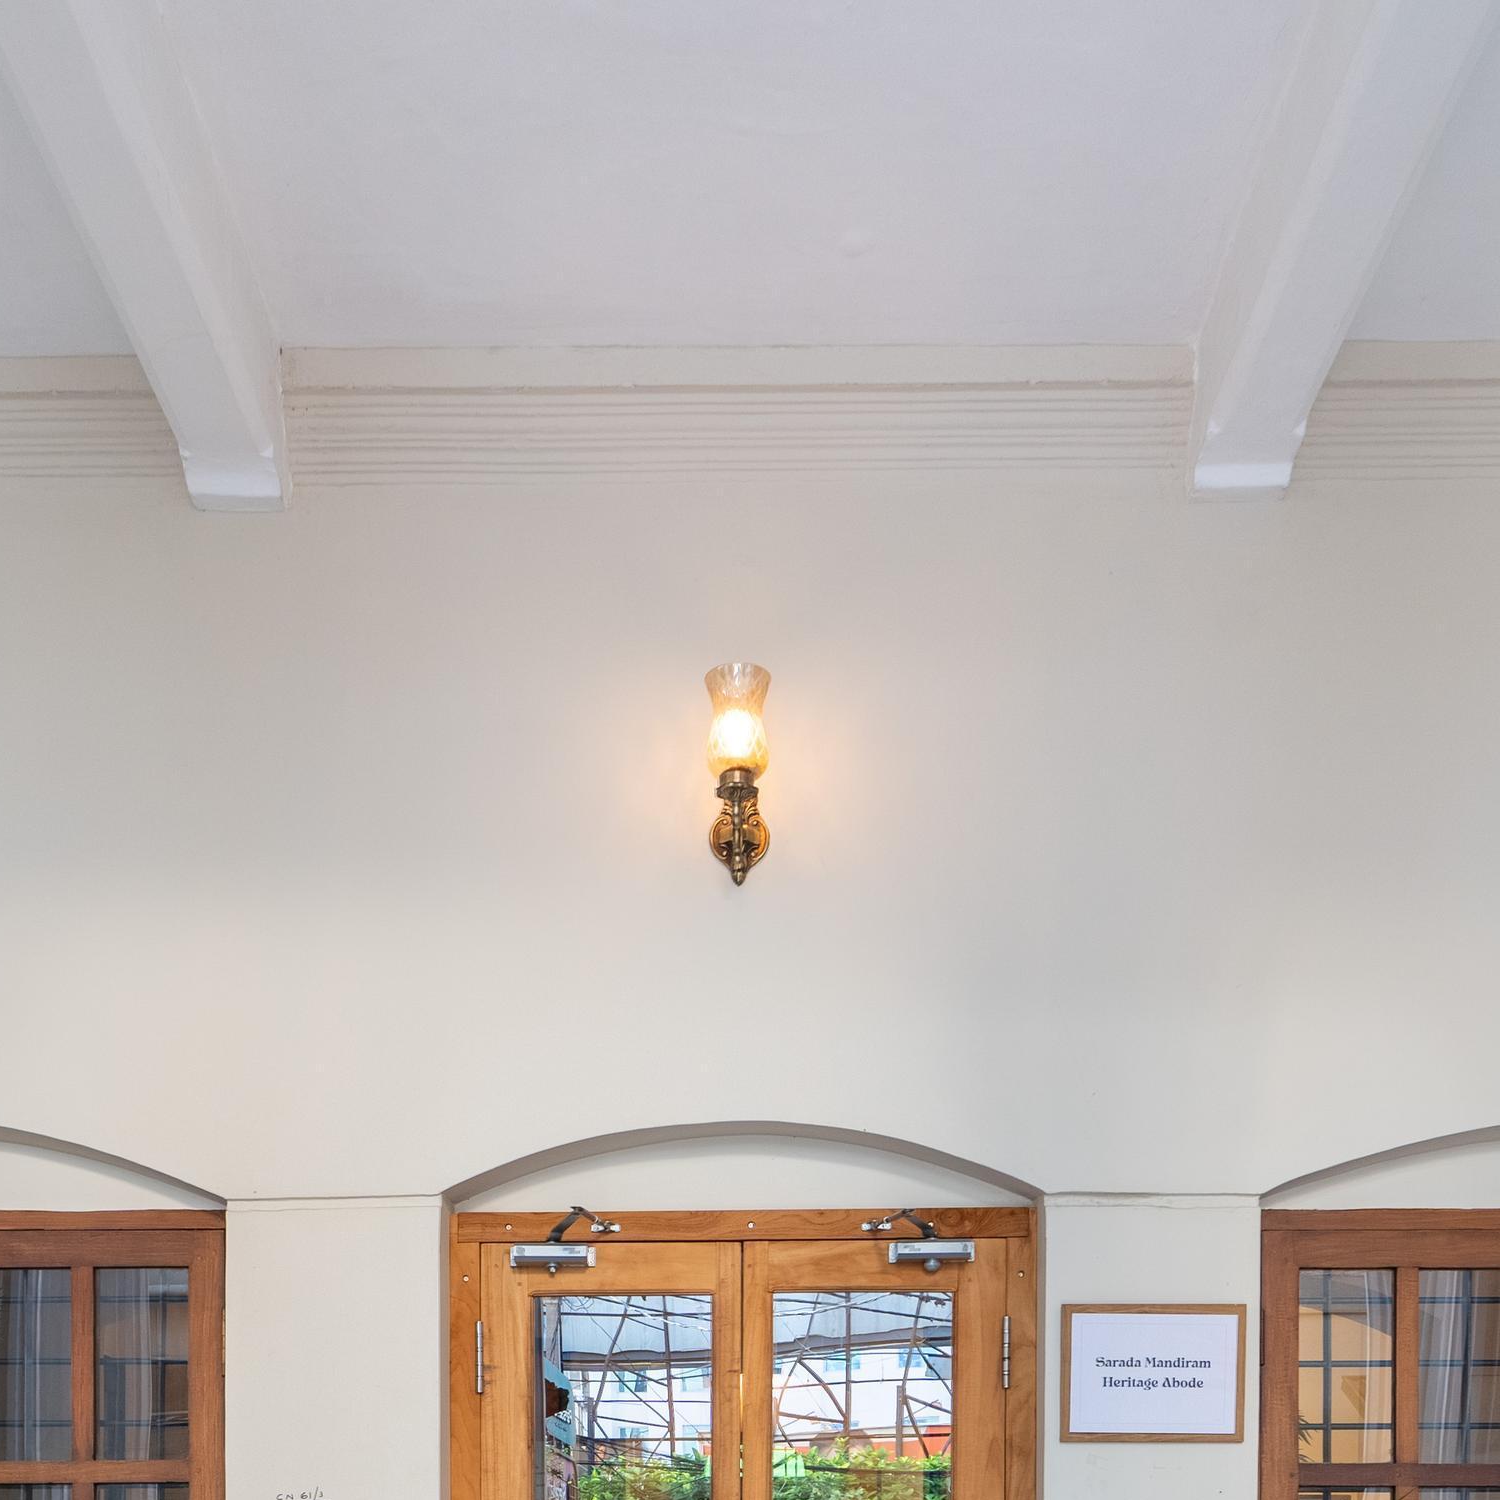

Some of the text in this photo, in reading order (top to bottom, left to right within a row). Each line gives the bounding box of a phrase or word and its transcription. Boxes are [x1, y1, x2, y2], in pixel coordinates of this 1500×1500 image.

[1095, 1356, 1211, 1369] Sarada Mandiram
[1102, 1376, 1204, 1391] Heritage Abode
